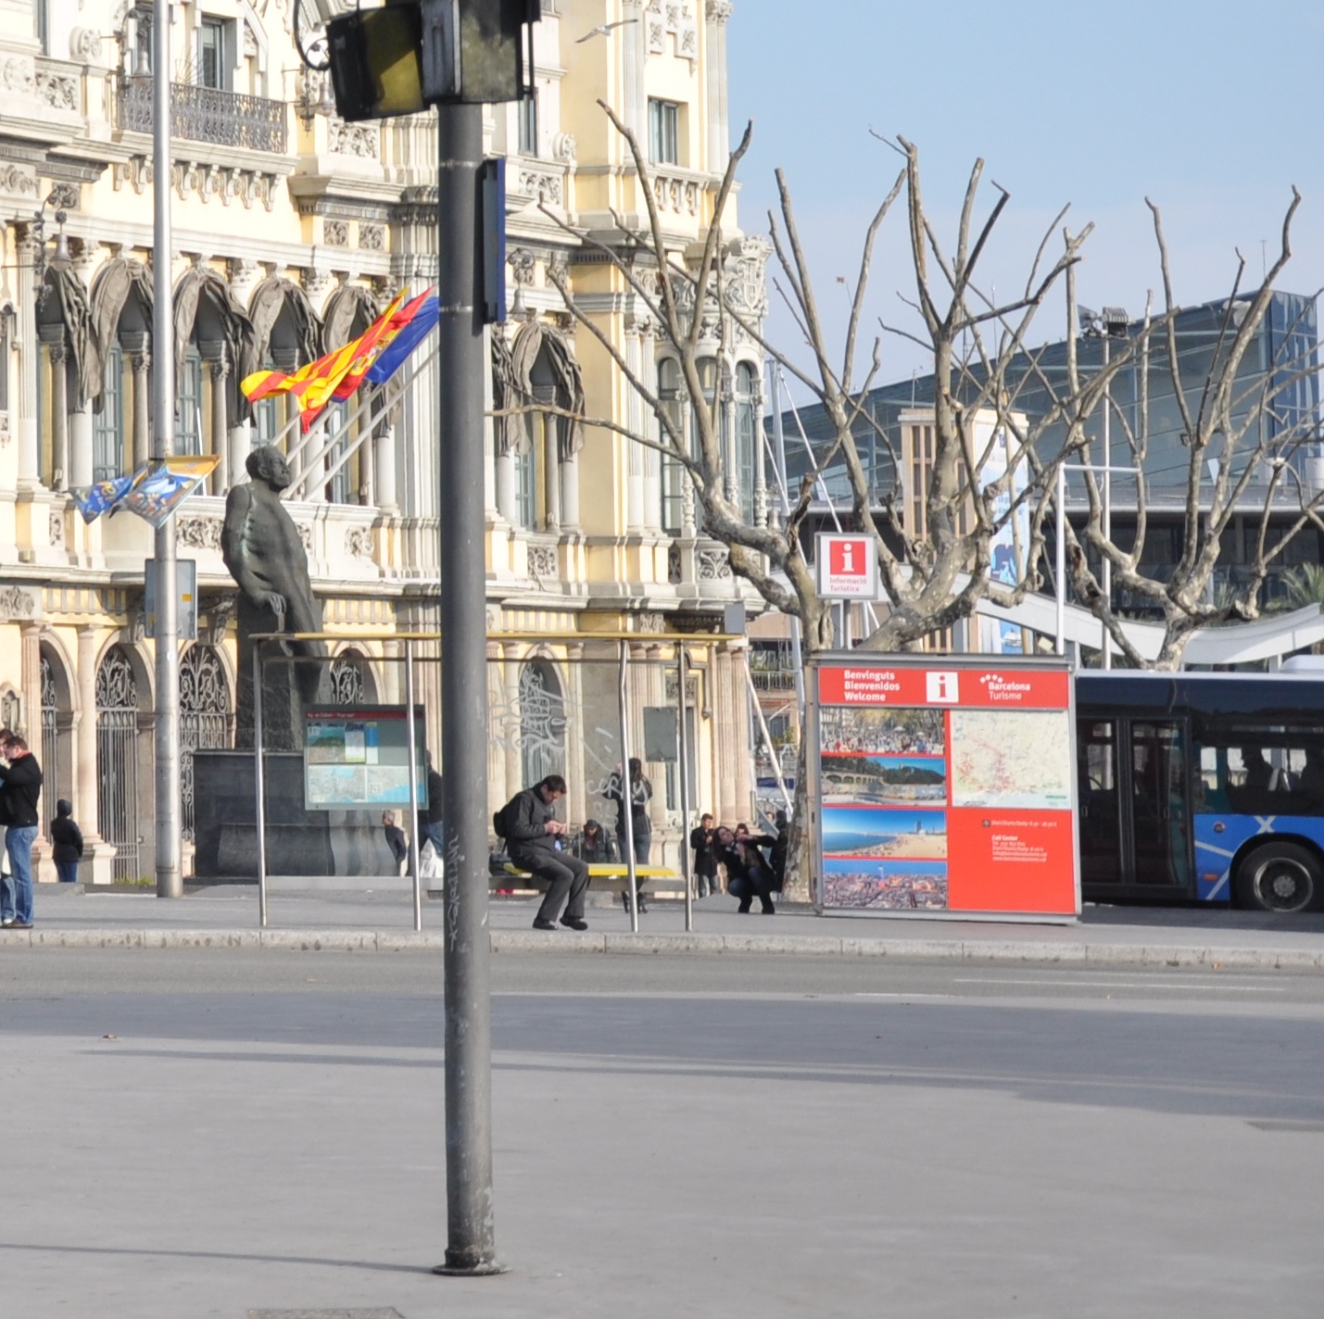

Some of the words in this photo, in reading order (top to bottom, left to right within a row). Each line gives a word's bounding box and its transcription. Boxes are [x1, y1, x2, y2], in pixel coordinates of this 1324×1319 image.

[844, 670, 896, 682] Benvinguts
[844, 681, 901, 691] Bienvenidos
[988, 682, 1031, 691] Barcelona
[844, 691, 886, 701] Welcome
[989, 691, 1022, 700] Turisme
